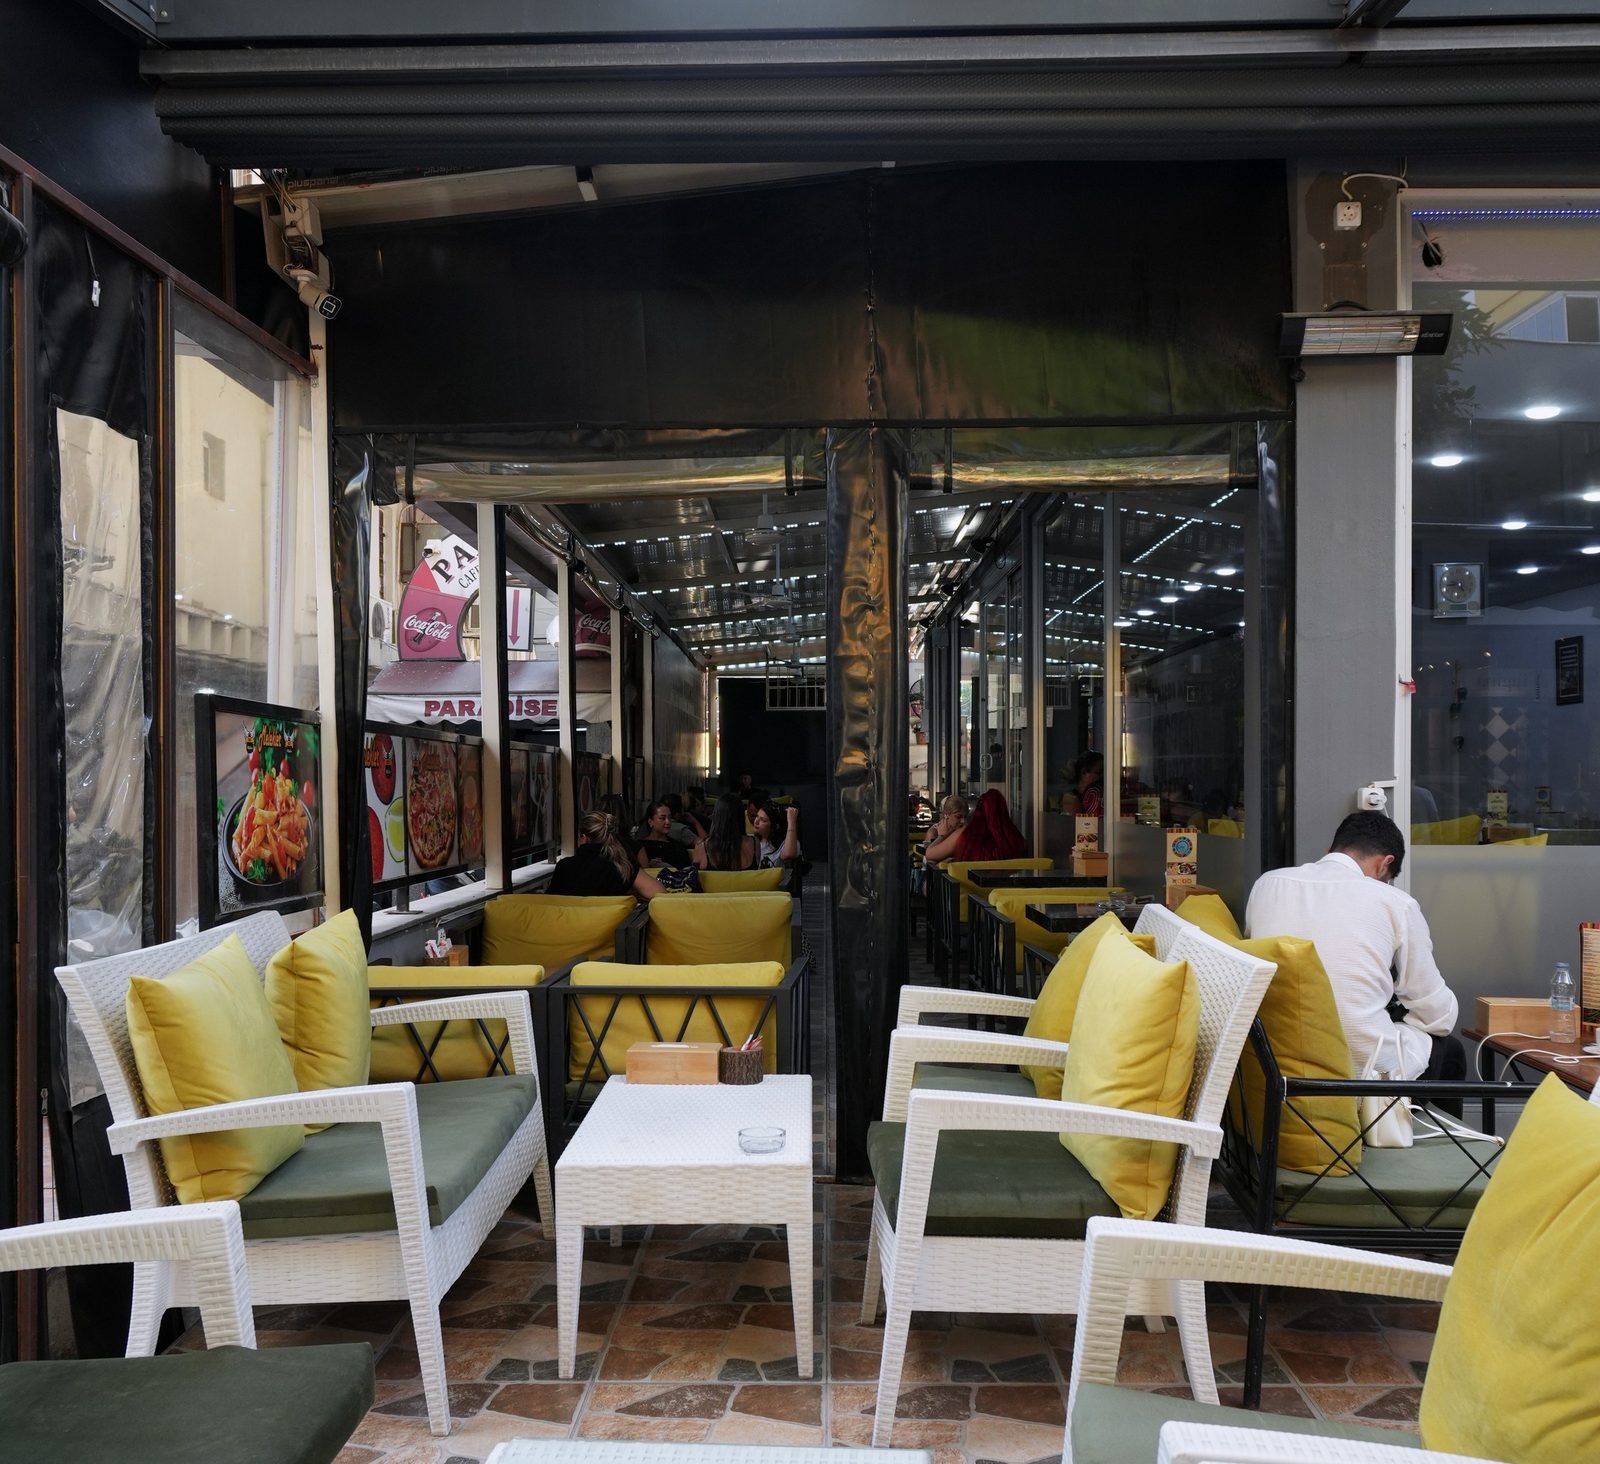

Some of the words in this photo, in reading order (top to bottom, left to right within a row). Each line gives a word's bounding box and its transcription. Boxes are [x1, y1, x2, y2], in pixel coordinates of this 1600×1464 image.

[431, 545, 478, 585] PA
[403, 614, 453, 640] Coca-Cola
[424, 696, 557, 717] PARİSE
